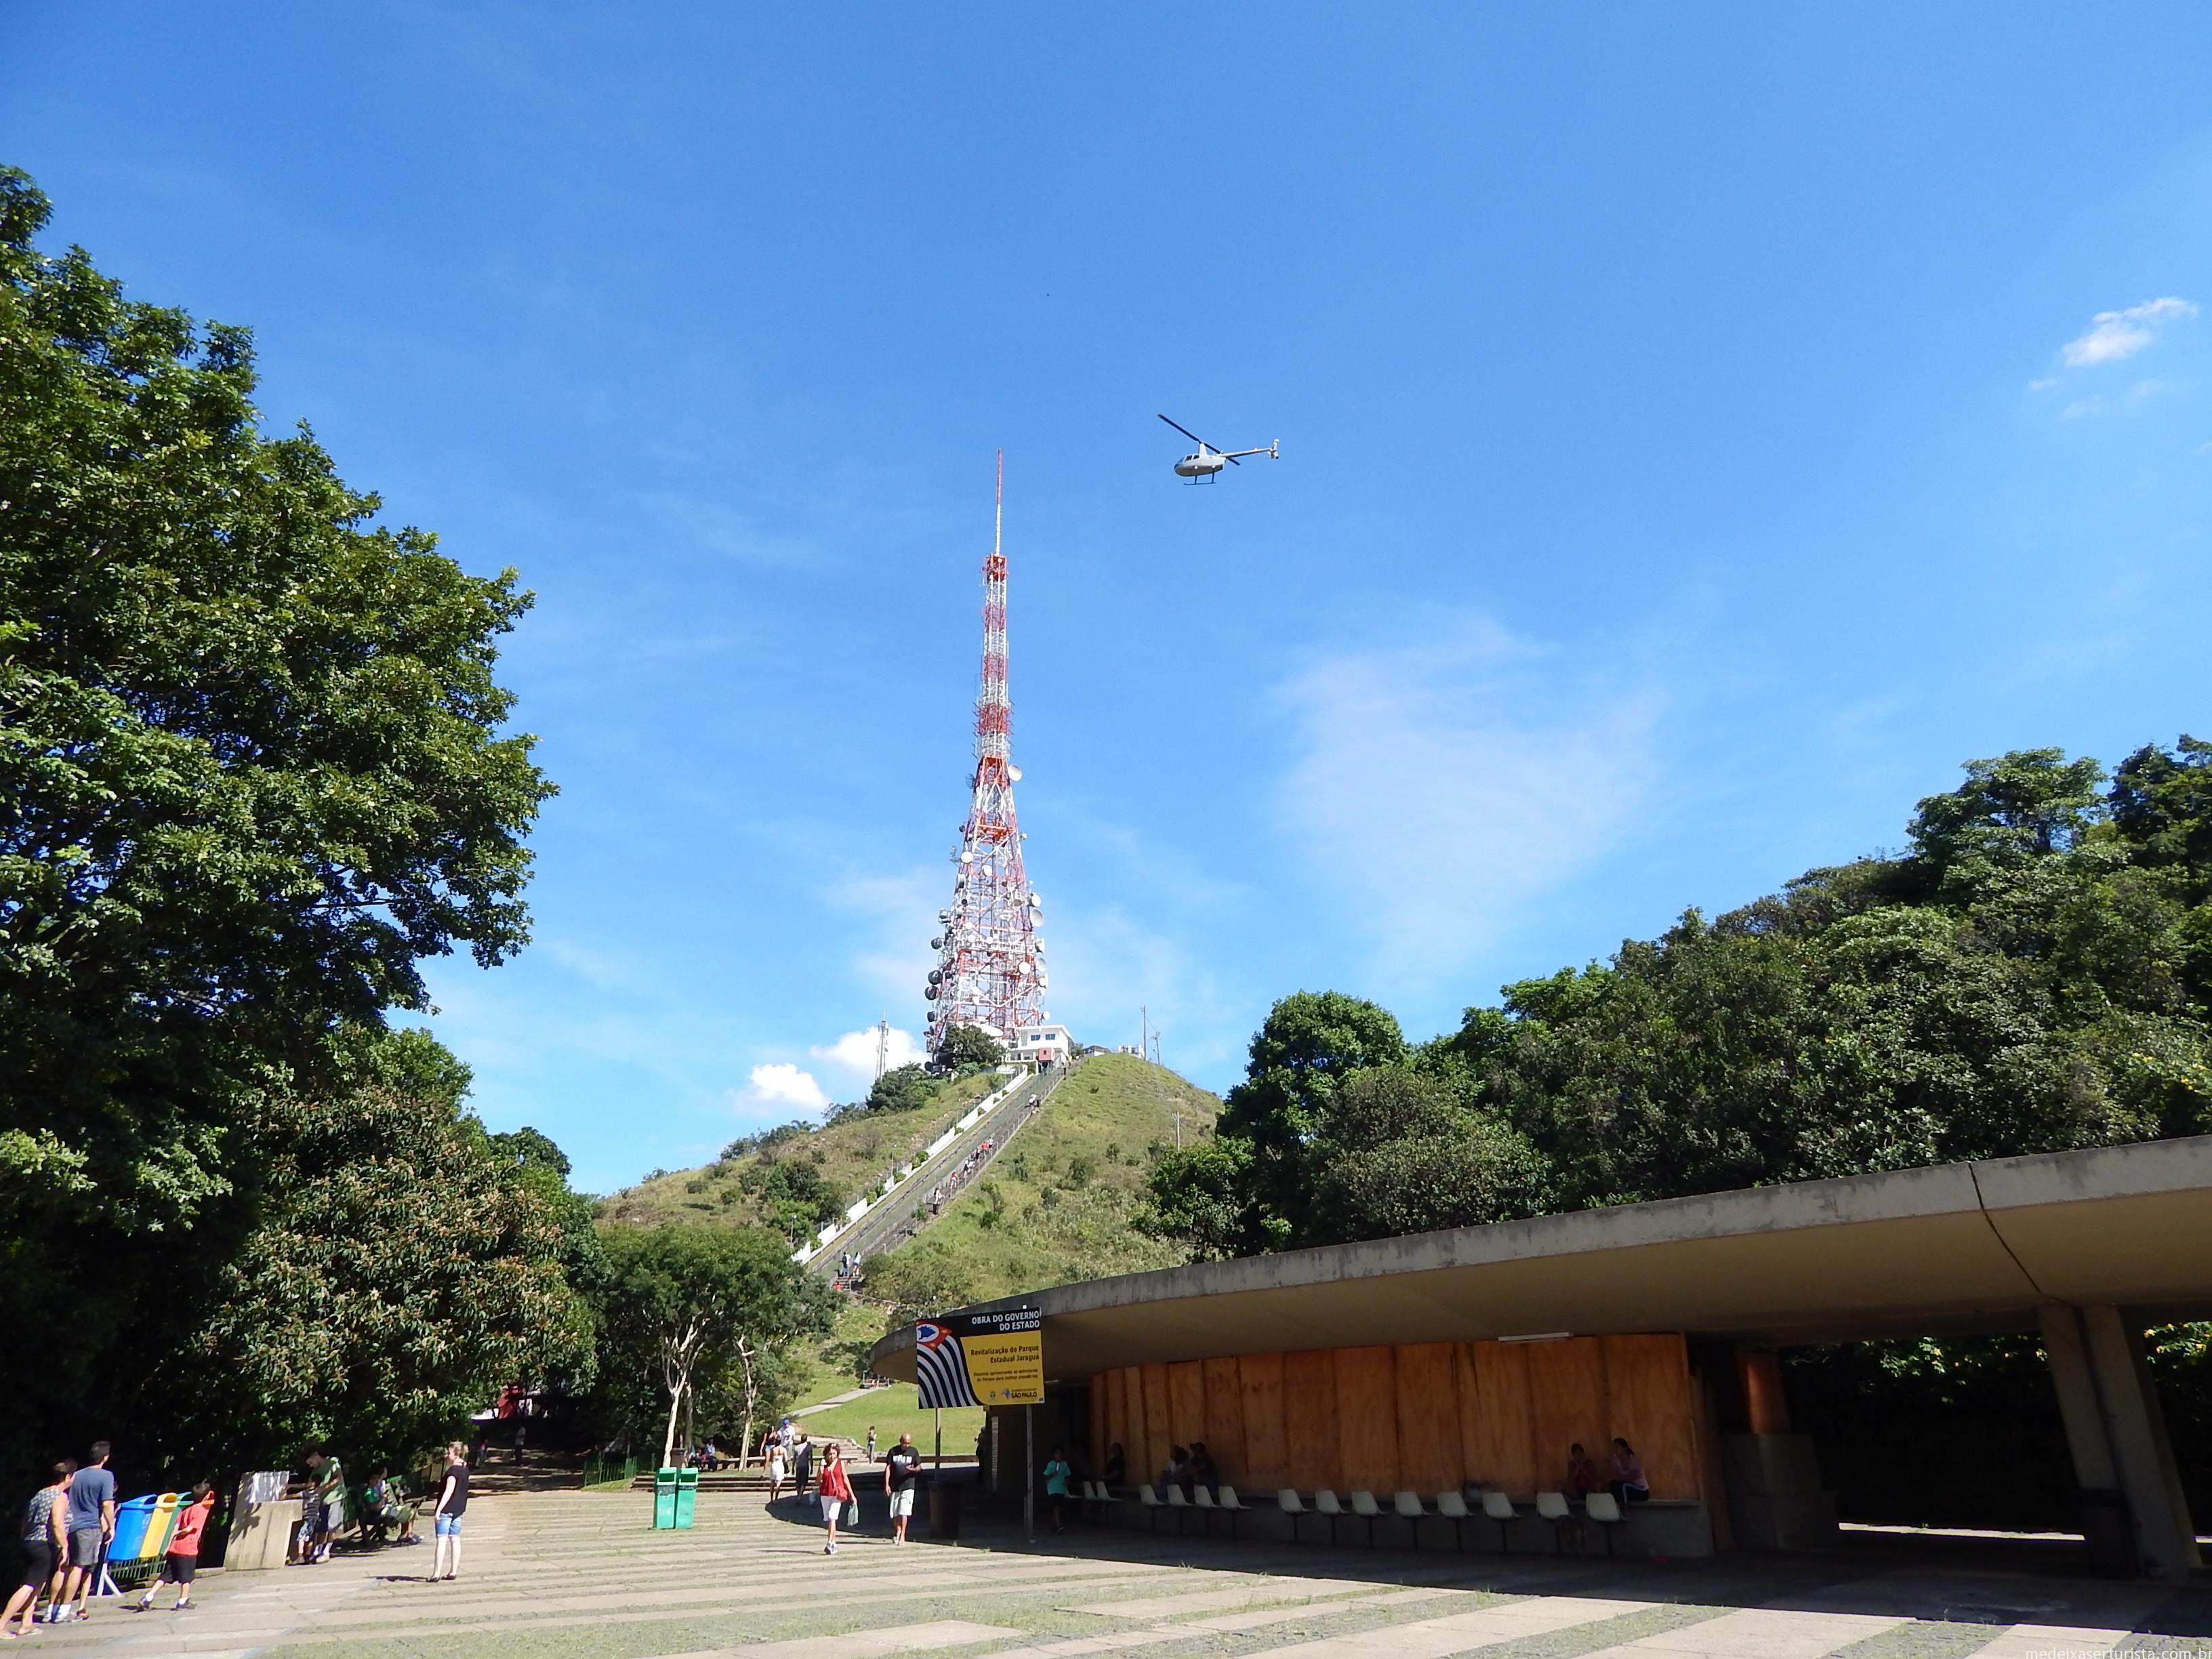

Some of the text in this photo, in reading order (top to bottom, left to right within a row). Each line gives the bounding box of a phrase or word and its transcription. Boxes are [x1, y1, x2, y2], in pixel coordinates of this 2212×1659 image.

[972, 1311, 1039, 1324] OBRA DO GOVERNO
[1000, 1320, 1040, 1331] DO ESTADO
[970, 1347, 1008, 1355] Revitalização
[1017, 1354, 1040, 1362] Jaraguá
